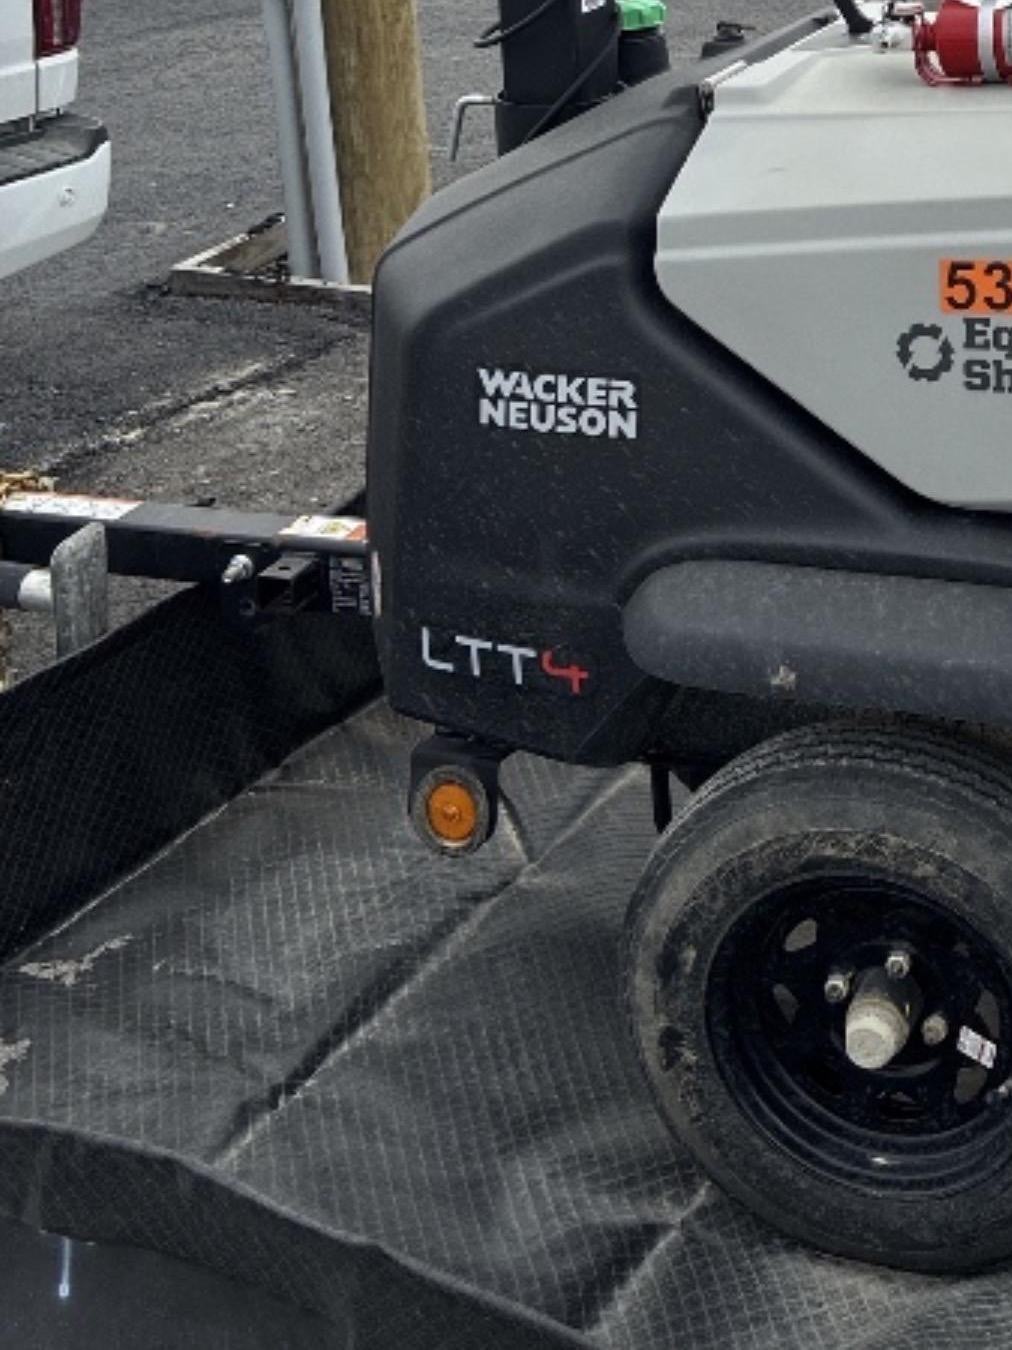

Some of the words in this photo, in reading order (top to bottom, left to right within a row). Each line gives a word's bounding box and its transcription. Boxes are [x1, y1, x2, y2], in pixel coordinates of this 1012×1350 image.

[476, 367, 638, 410] WACKER
[478, 398, 638, 440] NEUSON
[420, 625, 590, 696] LTT4
